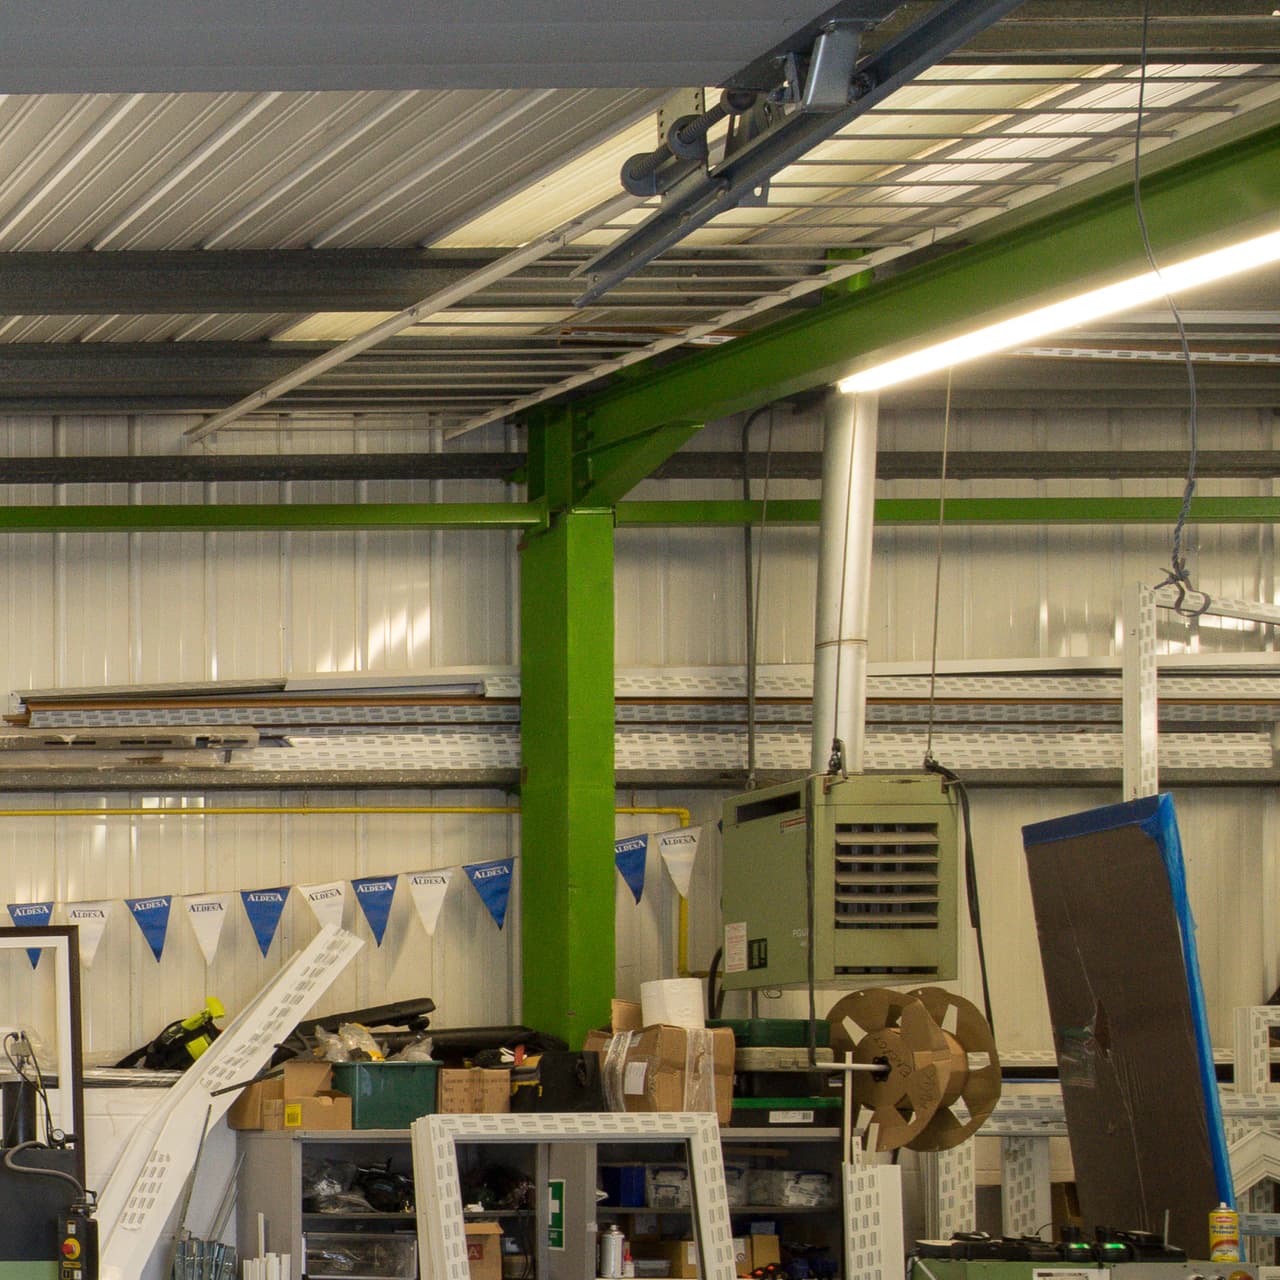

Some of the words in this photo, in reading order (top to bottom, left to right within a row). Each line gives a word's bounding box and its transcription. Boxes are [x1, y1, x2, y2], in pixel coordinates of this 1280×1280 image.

[660, 834, 697, 846] ALDESA
[473, 865, 510, 880] ALDESA
[411, 875, 446, 886] ALDESA
[357, 881, 393, 892] ALDESA
[247, 893, 283, 902] ALDESA
[307, 888, 342, 901] ALDESA
[133, 898, 169, 911] ALDESA
[188, 903, 224, 912] ALDESA
[13, 905, 49, 917] ALDESA
[69, 909, 105, 919] ALDESA
